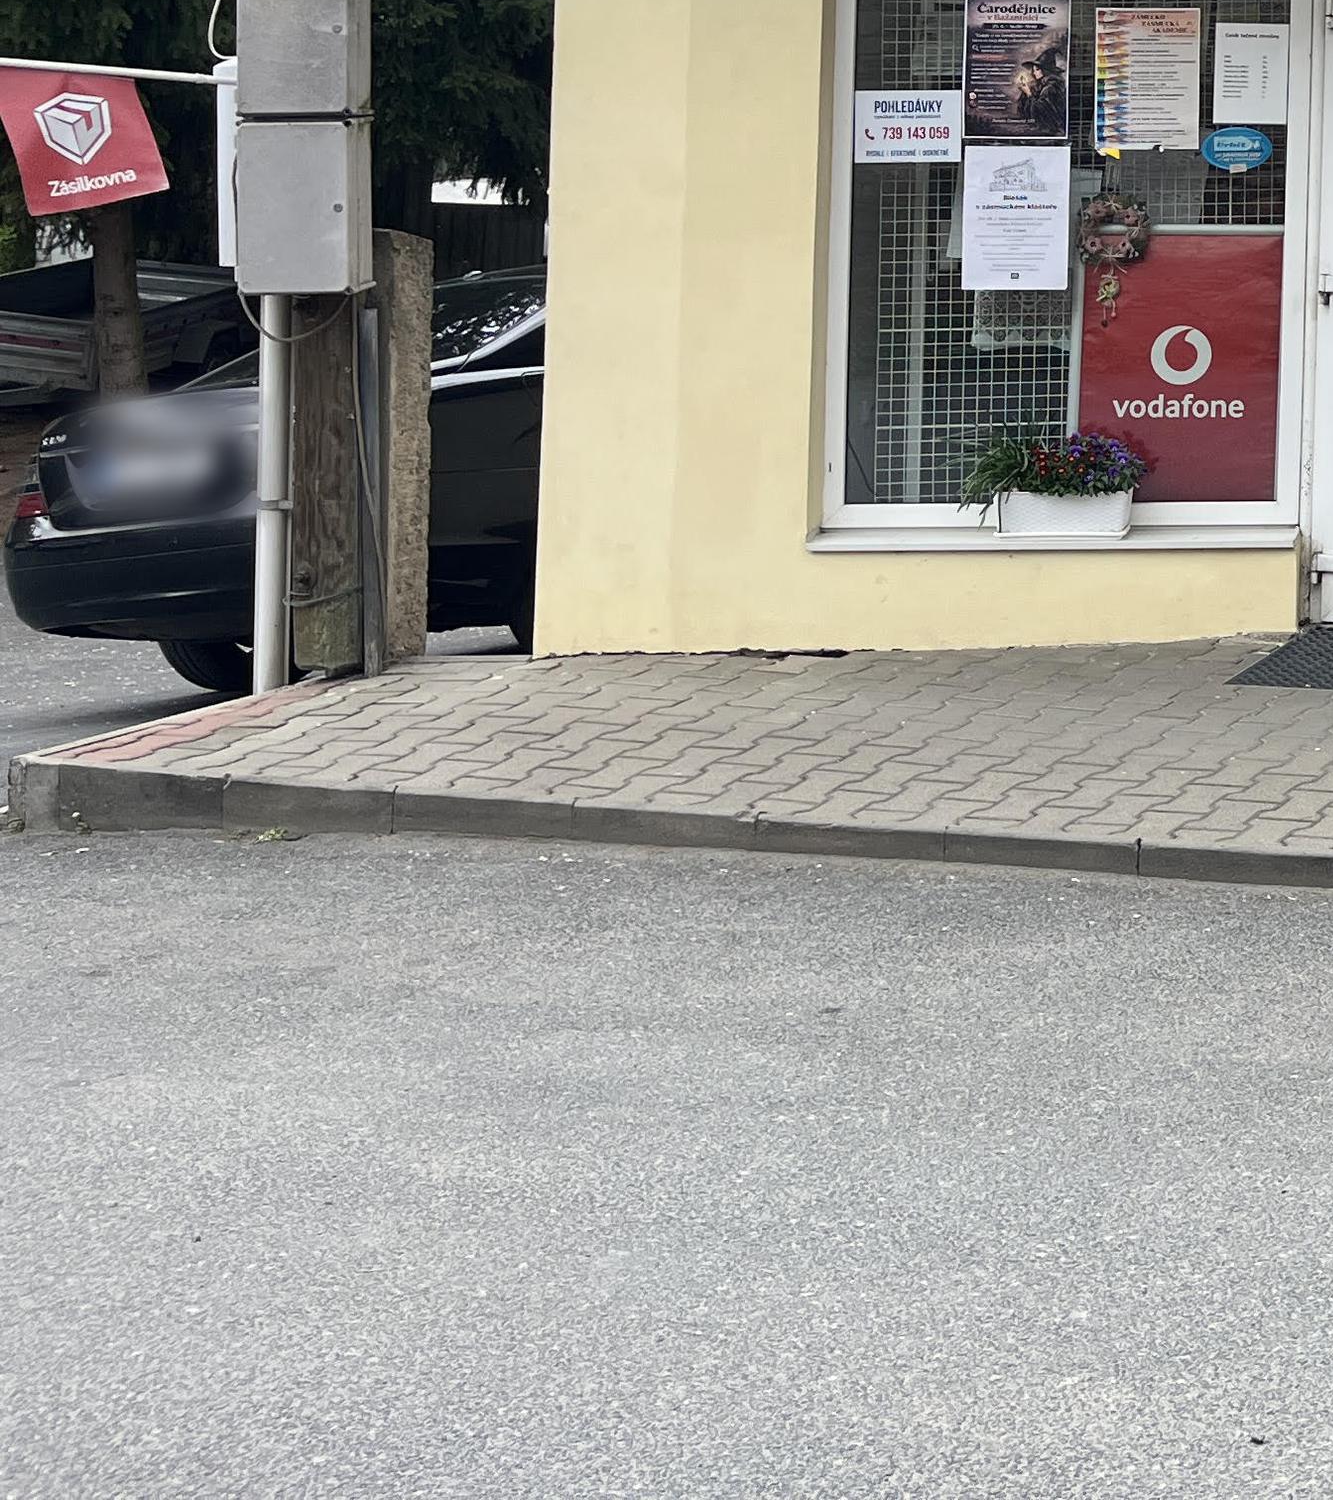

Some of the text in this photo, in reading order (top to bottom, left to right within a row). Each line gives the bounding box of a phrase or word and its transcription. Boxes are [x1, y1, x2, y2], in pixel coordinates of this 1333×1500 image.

[874, 97, 944, 114] POHLEDÁVKY
[881, 126, 950, 140] 739 143 059
[48, 169, 137, 197] Zásilkovna
[1112, 393, 1245, 419] vodafone
